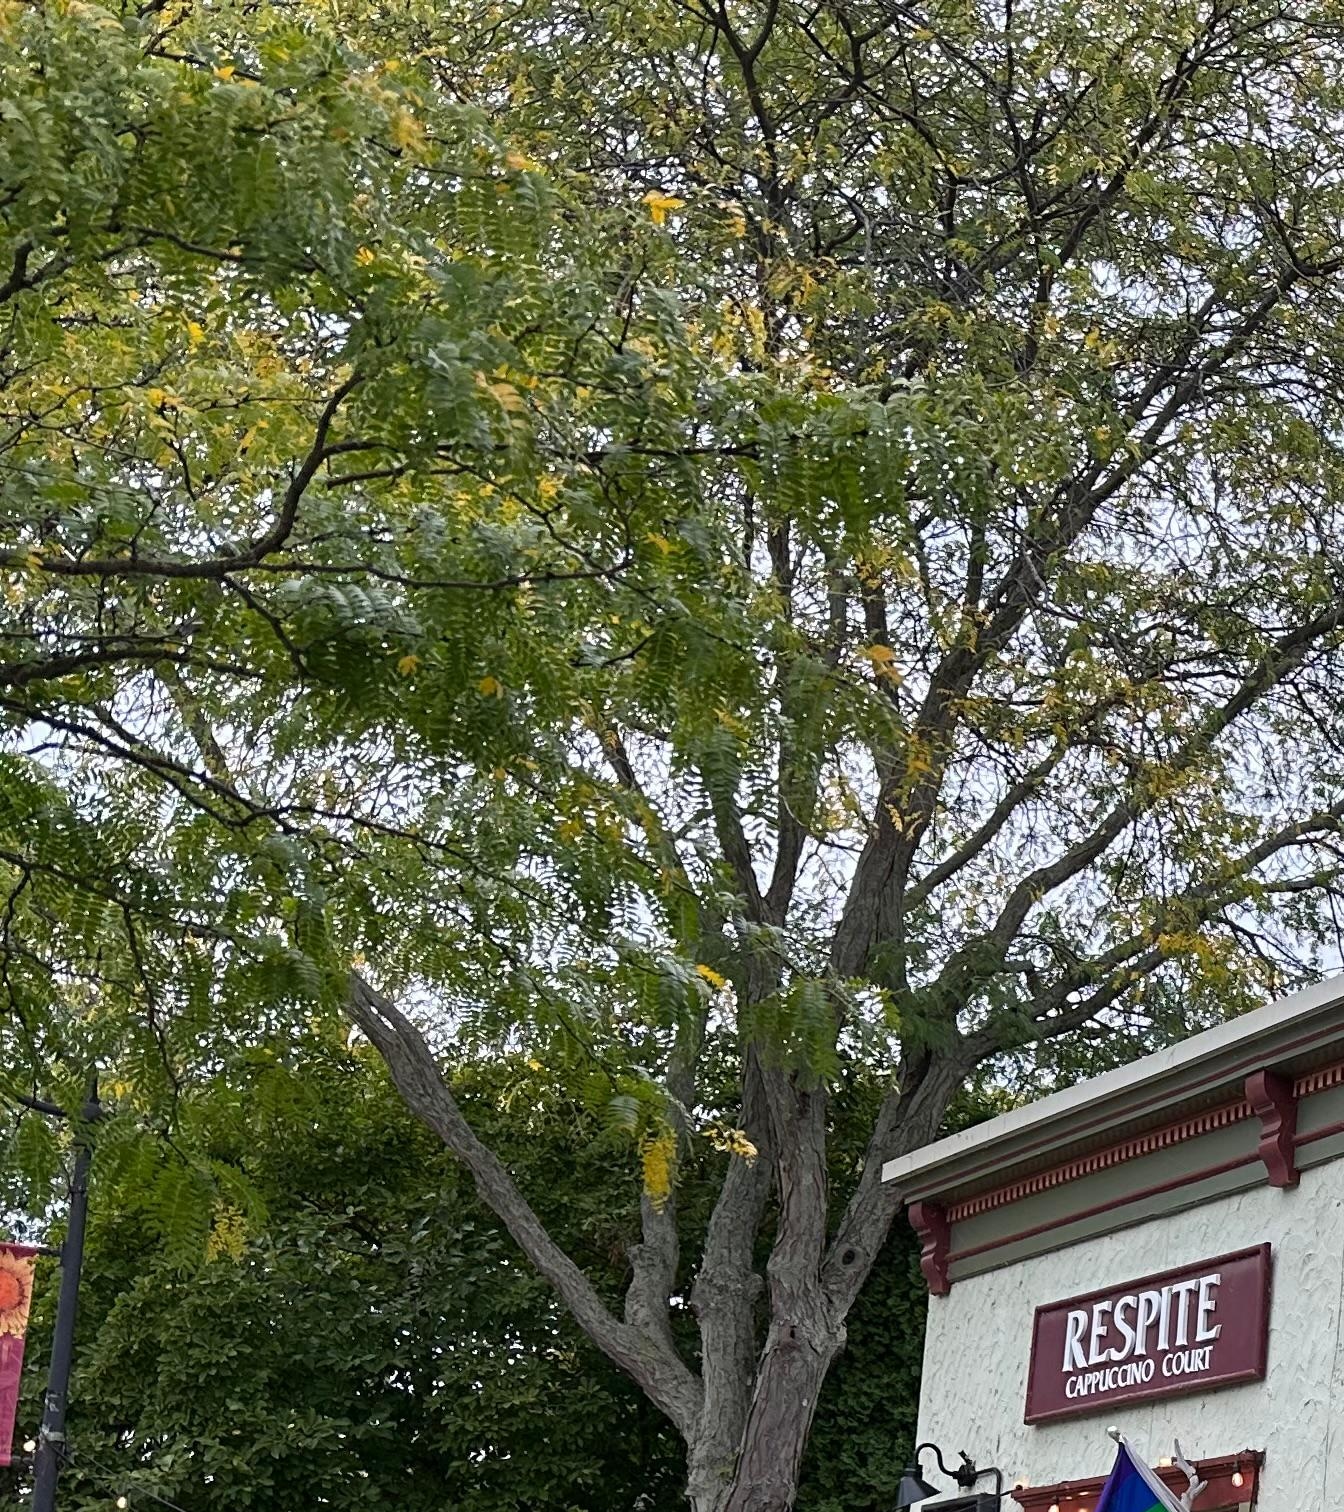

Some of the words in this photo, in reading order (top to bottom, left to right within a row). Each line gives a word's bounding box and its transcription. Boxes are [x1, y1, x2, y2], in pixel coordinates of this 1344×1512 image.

[1062, 1273, 1222, 1372] RESPITE
[1065, 1358, 1155, 1399] CAPPUCCINO
[1162, 1346, 1213, 1377] COURT
